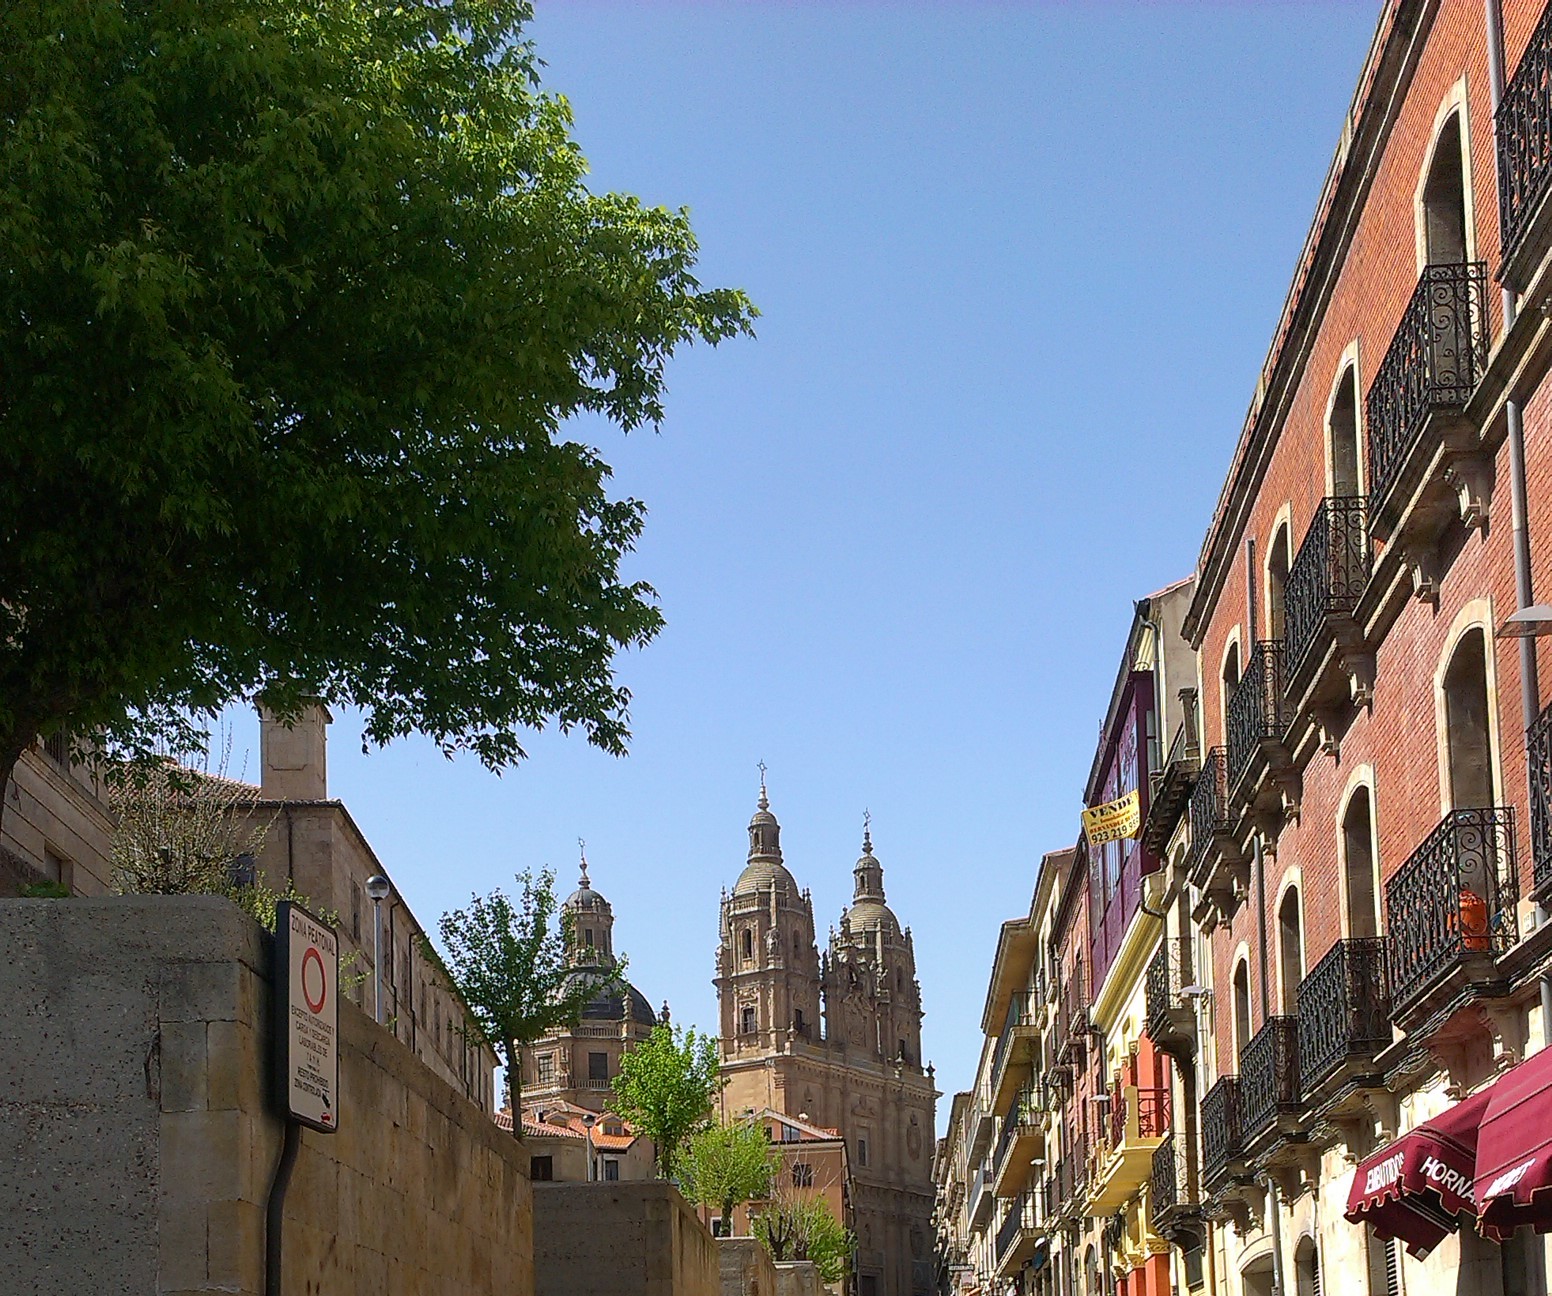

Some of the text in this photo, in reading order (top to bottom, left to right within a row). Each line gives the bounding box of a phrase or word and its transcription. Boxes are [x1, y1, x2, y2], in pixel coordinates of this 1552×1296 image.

[1089, 795, 1134, 819] VENDE
[1091, 831, 1110, 844] 923
[1110, 825, 1128, 838] 219
[291, 914, 335, 956] ZONA PEATONAL
[1419, 1155, 1477, 1206] HORNA
